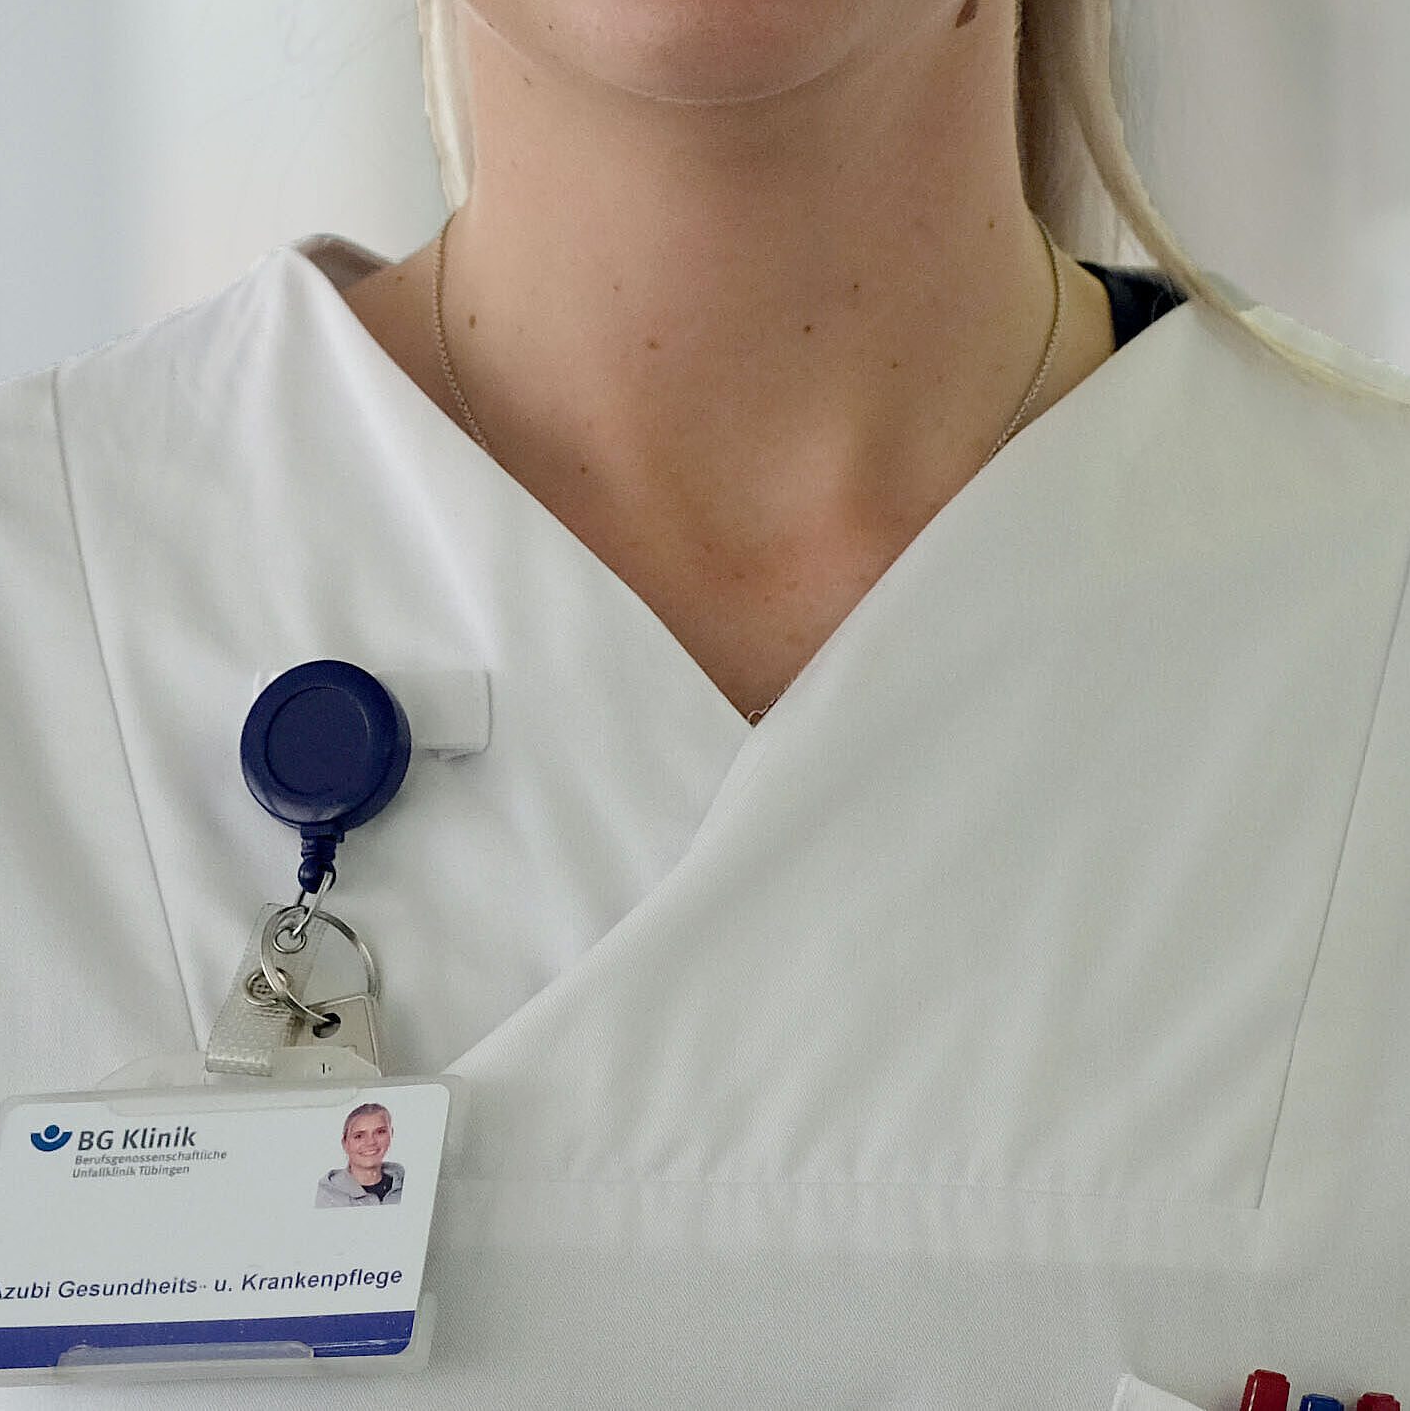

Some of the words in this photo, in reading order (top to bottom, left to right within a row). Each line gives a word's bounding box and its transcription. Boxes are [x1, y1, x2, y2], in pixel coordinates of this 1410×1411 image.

[78, 1130, 114, 1151] BG
[122, 1126, 197, 1150] Klinik
[75, 1150, 227, 1166] Berufsgenossenschaftliche
[72, 1167, 136, 1179] Unfallklinik
[139, 1164, 190, 1177] Tübingen
[214, 1279, 232, 1292] u.
[242, 1269, 403, 1291] Krankenpflege
